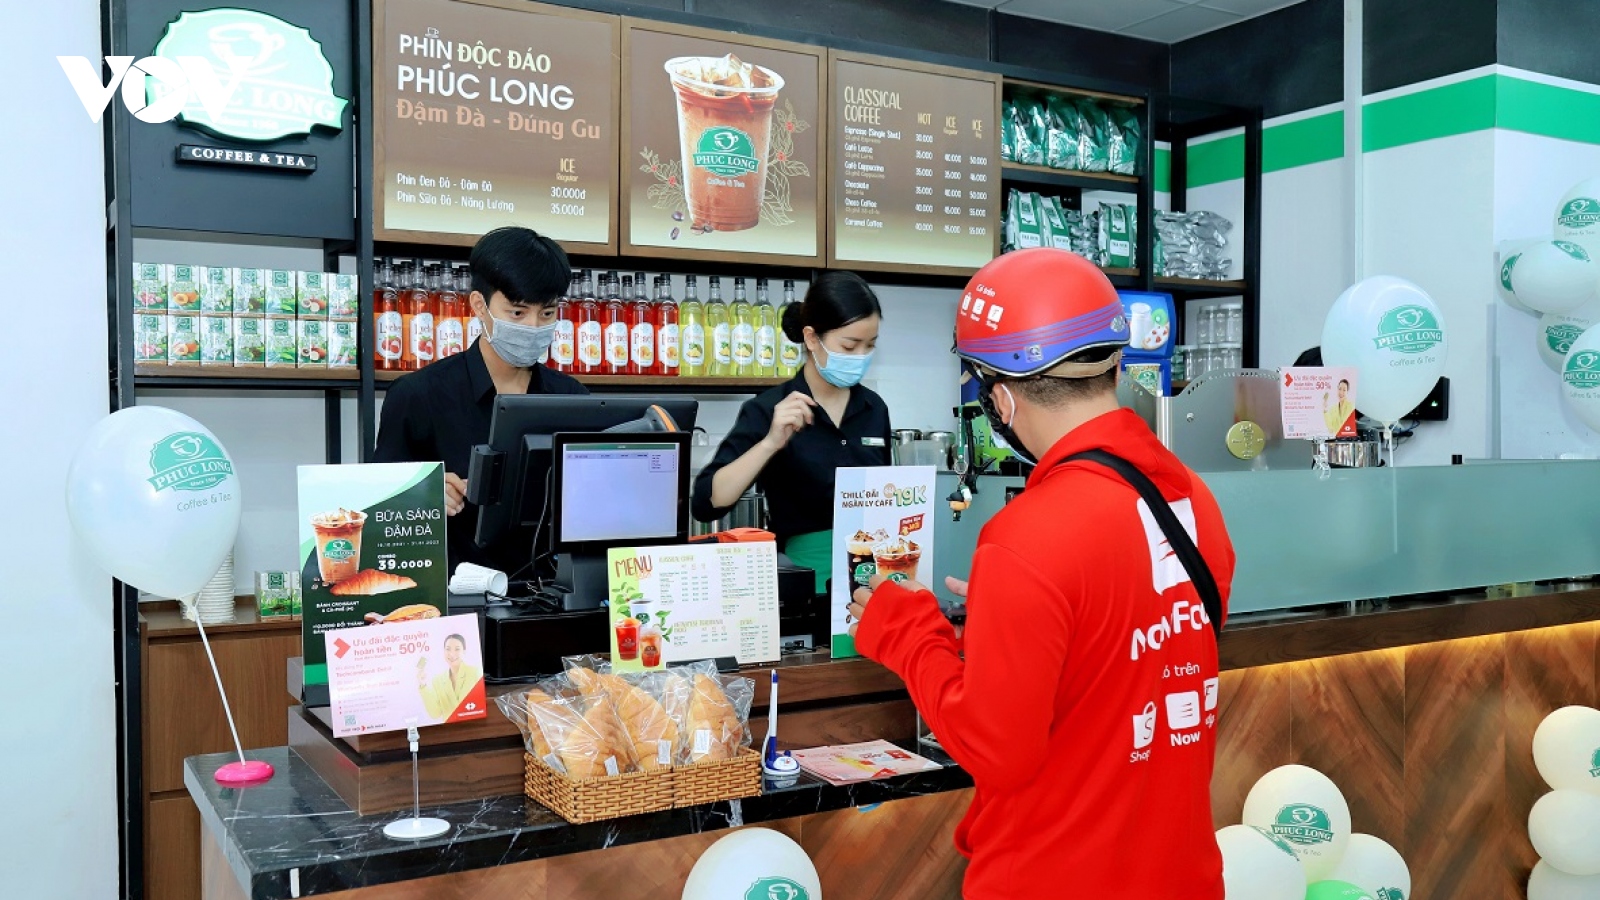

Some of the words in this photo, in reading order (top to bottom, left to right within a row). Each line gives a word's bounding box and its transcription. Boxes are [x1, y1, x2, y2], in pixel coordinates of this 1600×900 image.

[457, 40, 502, 70] ĐỘC
[507, 46, 551, 74] ĐÁO
[397, 62, 480, 100] PHÚC
[490, 76, 575, 111] LONG
[252, 87, 337, 120] LONG
[844, 86, 902, 111] CLASSICAL
[397, 98, 448, 126] Đậm
[455, 105, 486, 128] Đà
[507, 110, 564, 140] Đúng
[571, 118, 601, 140] Gu
[844, 104, 881, 126] COFFEE
[917, 112, 932, 126] HOT
[945, 115, 957, 129] ICE
[971, 119, 982, 132] ICE
[192, 148, 253, 162] COFFEE
[259, 153, 270, 163] &
[275, 154, 306, 167] TEA
[696, 155, 725, 165] PHUC
[727, 156, 755, 170] LONG
[560, 158, 576, 173] ICE
[397, 173, 416, 186] Phin
[397, 191, 416, 203] Phin
[461, 196, 484, 210] Năng
[551, 186, 586, 200] 30.000đ
[551, 203, 585, 216] 35.000đ
[1378, 332, 1414, 347] PHUC
[1416, 331, 1441, 341] LONG
[1390, 358, 1415, 367] Coffee
[1316, 381, 1331, 390] 50%
[154, 464, 199, 489] PHUC
[200, 461, 231, 472] LONG
[177, 498, 207, 512] Coffee
[218, 493, 231, 502] Tea
[875, 499, 893, 507] CAFE
[893, 485, 927, 507] 19K
[375, 508, 404, 522] BỮA
[406, 507, 441, 521] SÁNG
[385, 523, 412, 539] ĐẬM
[415, 522, 433, 536] ĐÀ
[615, 555, 653, 578] MENU
[384, 635, 400, 643] đặc
[403, 631, 429, 641] quyền
[354, 648, 375, 656] hoàn
[399, 641, 430, 655] 50%
[1174, 662, 1200, 677] trên
[1170, 731, 1201, 747] Now
[1274, 826, 1303, 835] PHUC
[1304, 828, 1330, 840] LONG
